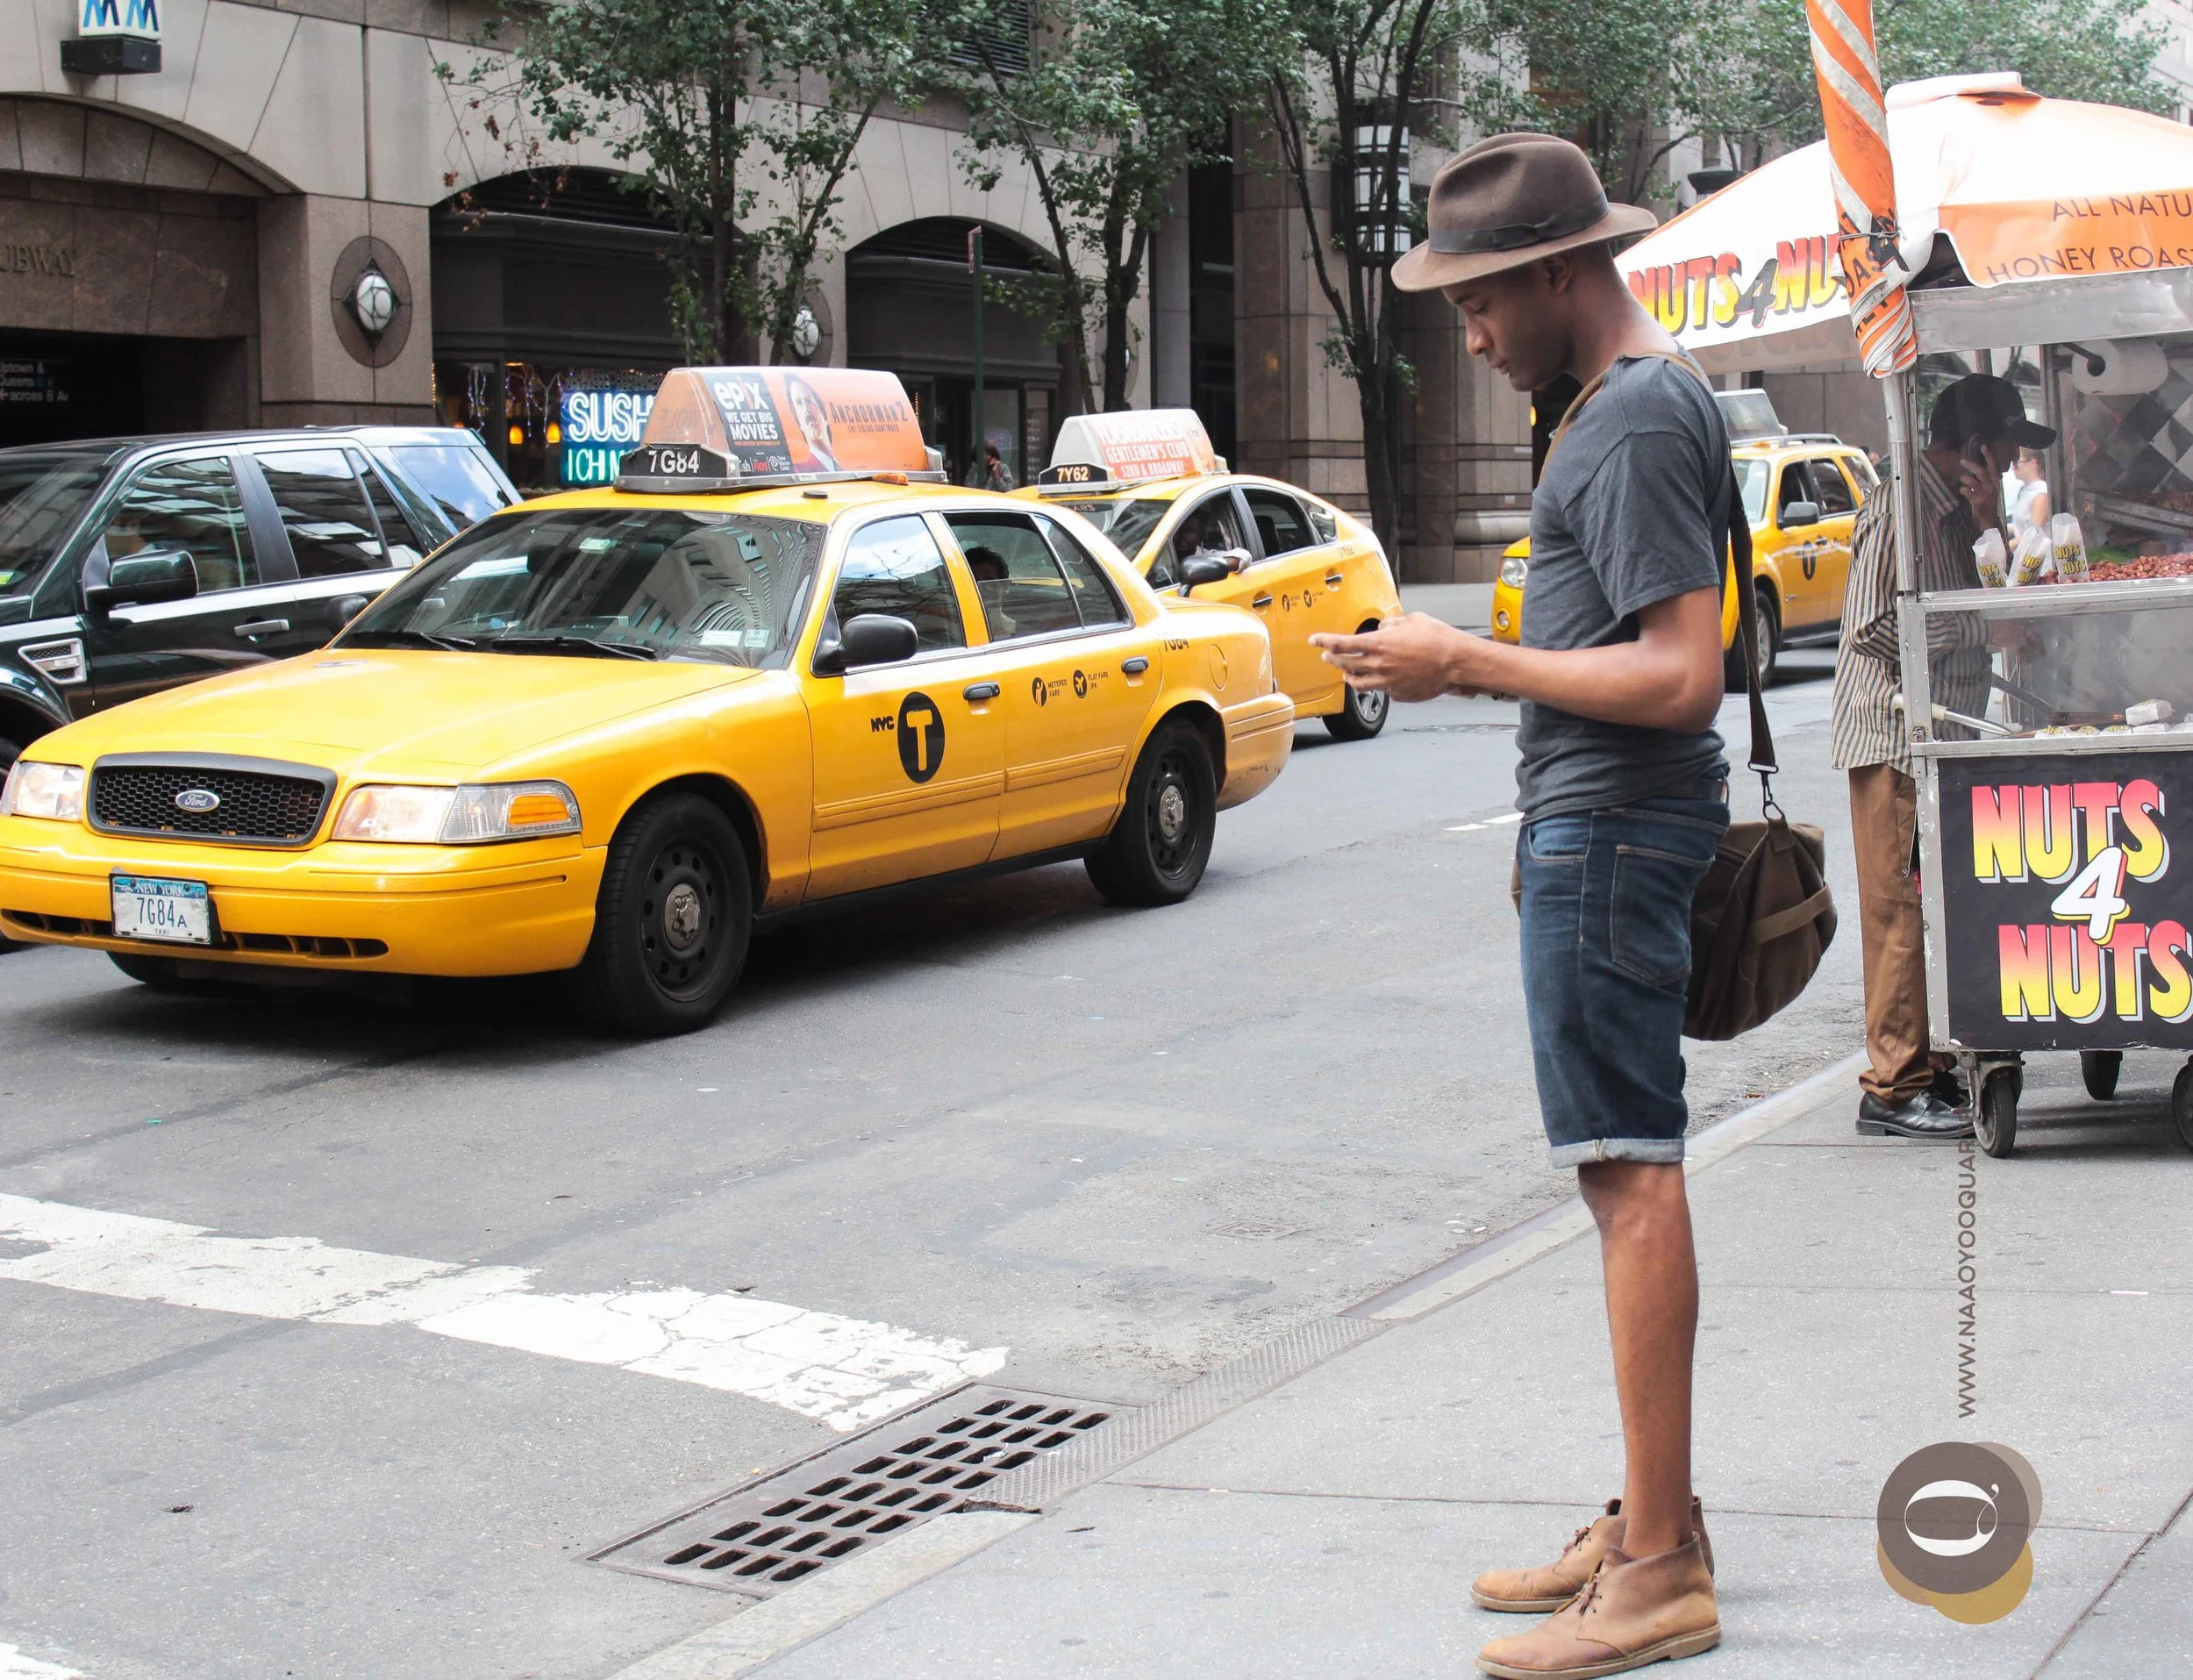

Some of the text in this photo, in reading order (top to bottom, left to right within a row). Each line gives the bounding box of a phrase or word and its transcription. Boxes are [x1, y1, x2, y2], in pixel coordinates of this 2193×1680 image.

[2054, 194, 2193, 221] ALL NATU
[1987, 246, 2193, 283] HONEY ROAS
[1628, 251, 1742, 337] NUTS
[1735, 258, 1778, 329] 4
[714, 376, 769, 411] epix
[568, 392, 655, 442] SUSH
[724, 411, 774, 423] WE GET BIG
[829, 401, 908, 424] ANCHORMAN 2
[729, 424, 778, 440] MOVIES
[648, 450, 699, 474] 7G84
[1105, 441, 1190, 463] GENTLEMEN'S CLUB
[1057, 466, 1089, 483] 7Y62
[1148, 461, 1186, 475] BROADWAY
[2055, 545, 2082, 560] NUTS
[2062, 561, 2087, 575] NUTS
[1047, 679, 1068, 688] METERED
[870, 709, 933, 771] NYC T
[185, 793, 208, 807] Ford
[1971, 778, 2170, 884] NUTS
[137, 883, 184, 897] NEW YORK
[2050, 845, 2131, 946] 4
[1998, 919, 2193, 1025] NUTS
